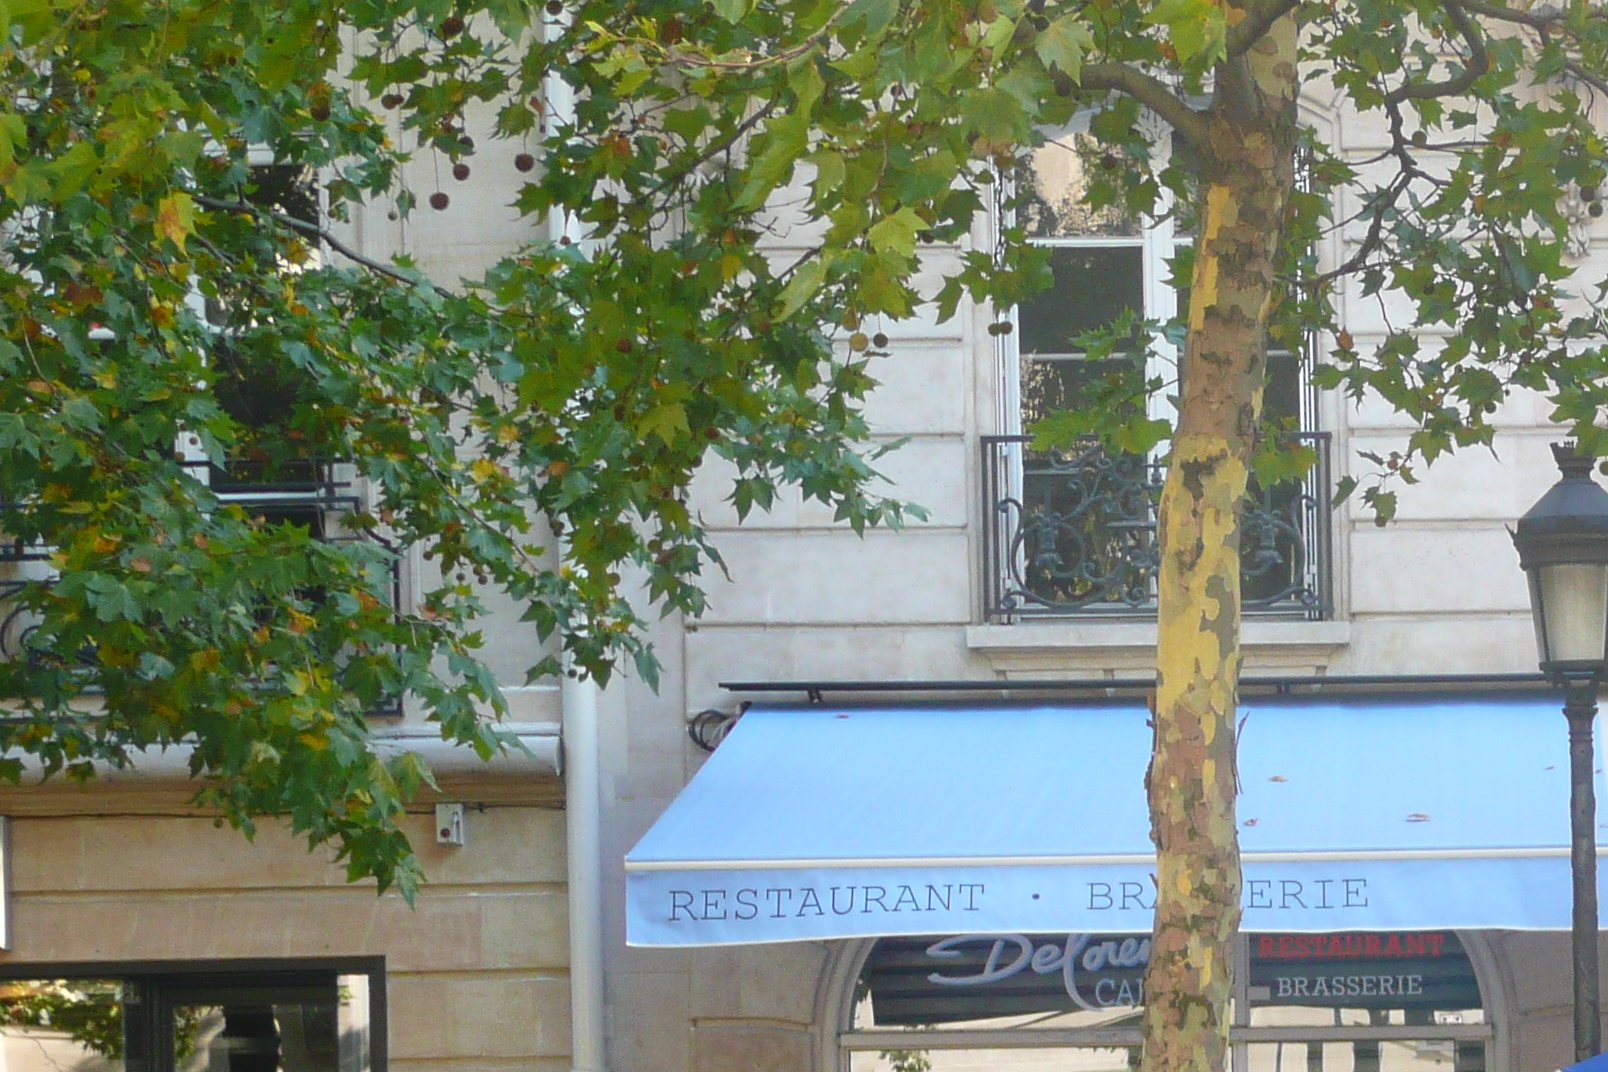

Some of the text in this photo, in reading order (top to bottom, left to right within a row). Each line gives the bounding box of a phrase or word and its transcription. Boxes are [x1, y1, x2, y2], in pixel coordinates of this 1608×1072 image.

[667, 883, 985, 922] RESTAURANT
[1086, 878, 1370, 911] BRERIE
[1258, 933, 1446, 959] RESTAURANT
[1094, 977, 1145, 1008] CA
[1277, 974, 1423, 998] BRASSERIE
